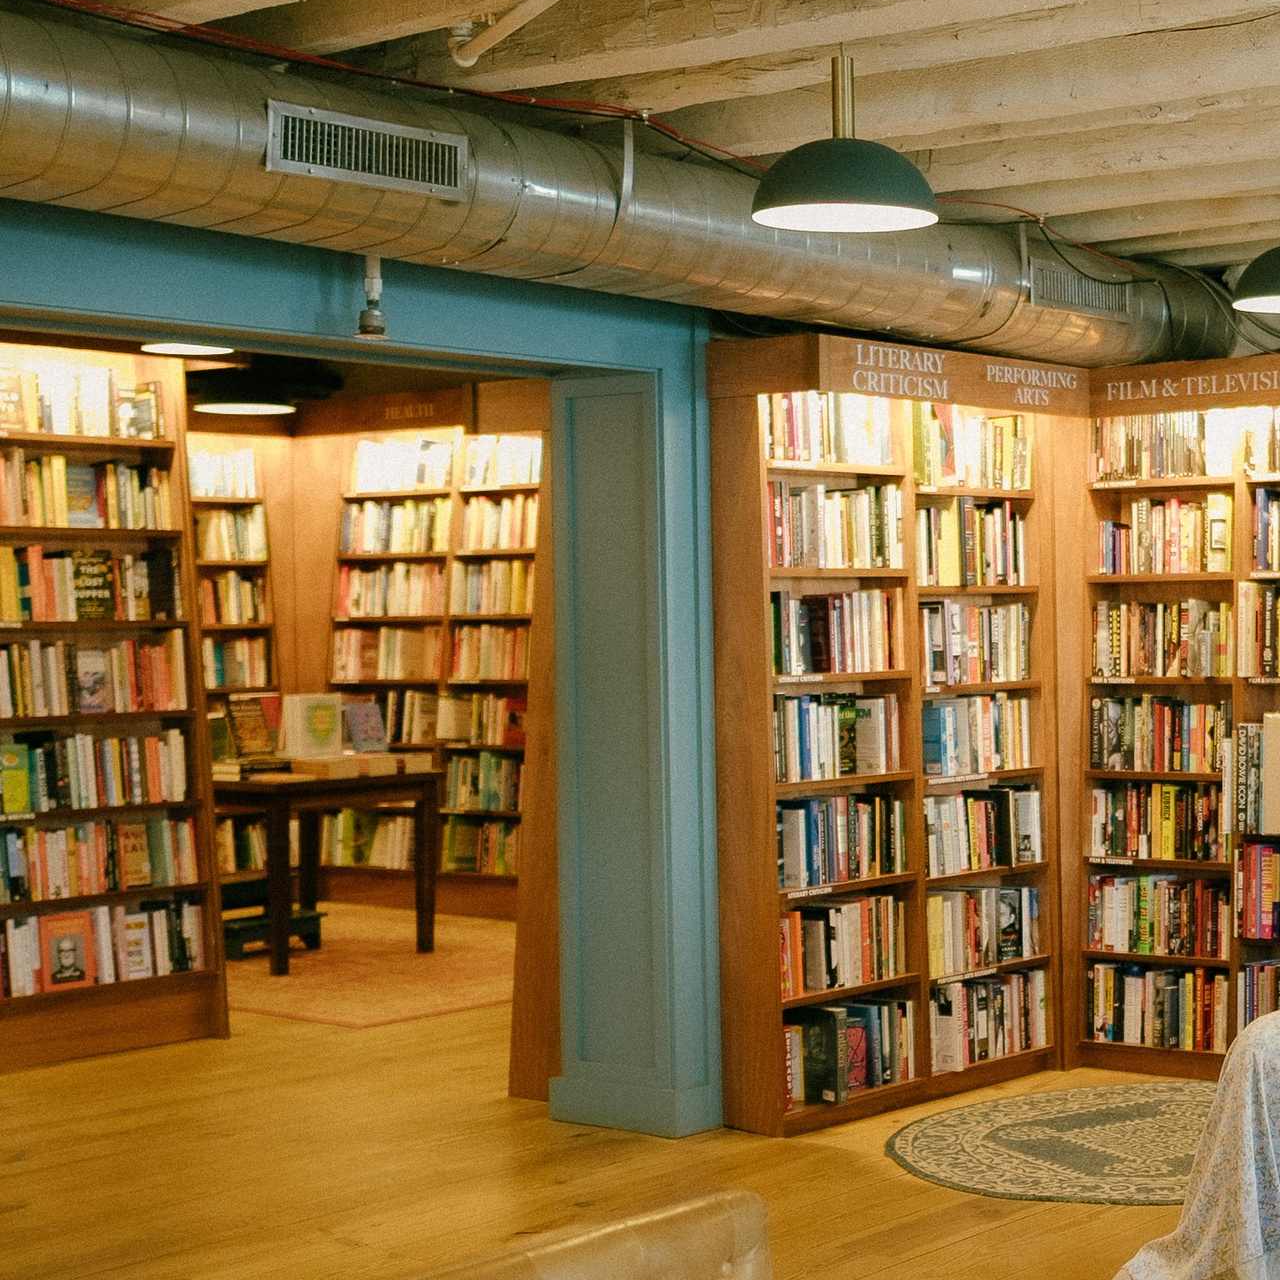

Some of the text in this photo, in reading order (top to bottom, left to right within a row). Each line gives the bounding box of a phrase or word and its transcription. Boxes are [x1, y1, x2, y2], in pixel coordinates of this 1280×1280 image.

[856, 344, 945, 374] LITERARY
[853, 370, 948, 400] CRITICISM
[987, 365, 1077, 389] PERFORMING
[1106, 379, 1156, 401] FILM
[1162, 379, 1179, 397] &
[1014, 389, 1049, 405] ARTS
[1238, 729, 1247, 809] DAVID BOWIE ICON
[1162, 791, 1171, 821] KUBRICK
[1140, 885, 1148, 901] CUE
[1261, 857, 1273, 912] ELTON JOHN
[1140, 904, 1148, 920] THE
